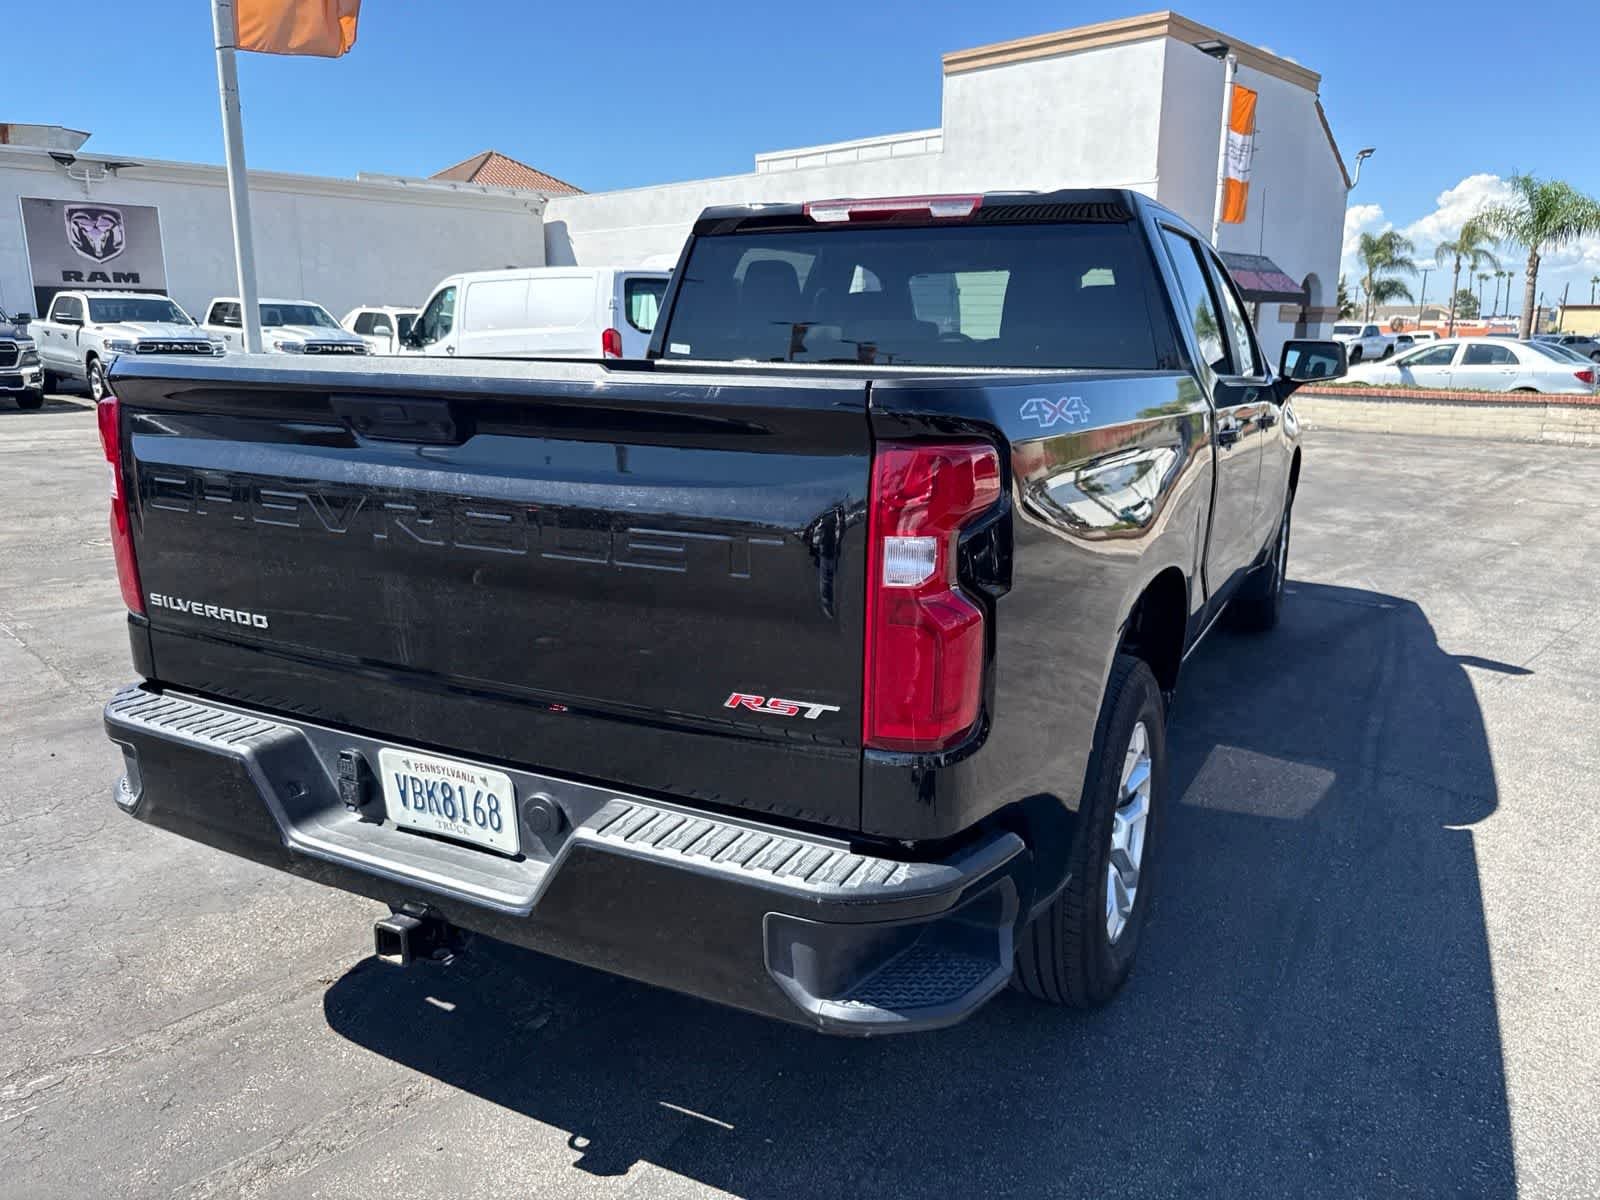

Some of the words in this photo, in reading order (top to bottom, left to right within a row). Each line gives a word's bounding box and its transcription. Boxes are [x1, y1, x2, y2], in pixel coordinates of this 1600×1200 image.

[62, 270, 140, 283] RAM
[147, 473, 785, 578] CHEVROLET
[149, 592, 269, 629] SILVERADO
[723, 692, 841, 720] RST
[414, 763, 476, 784] PENNSYLVANIA
[394, 773, 503, 833] VBK8168
[434, 820, 470, 836] TRUCK
